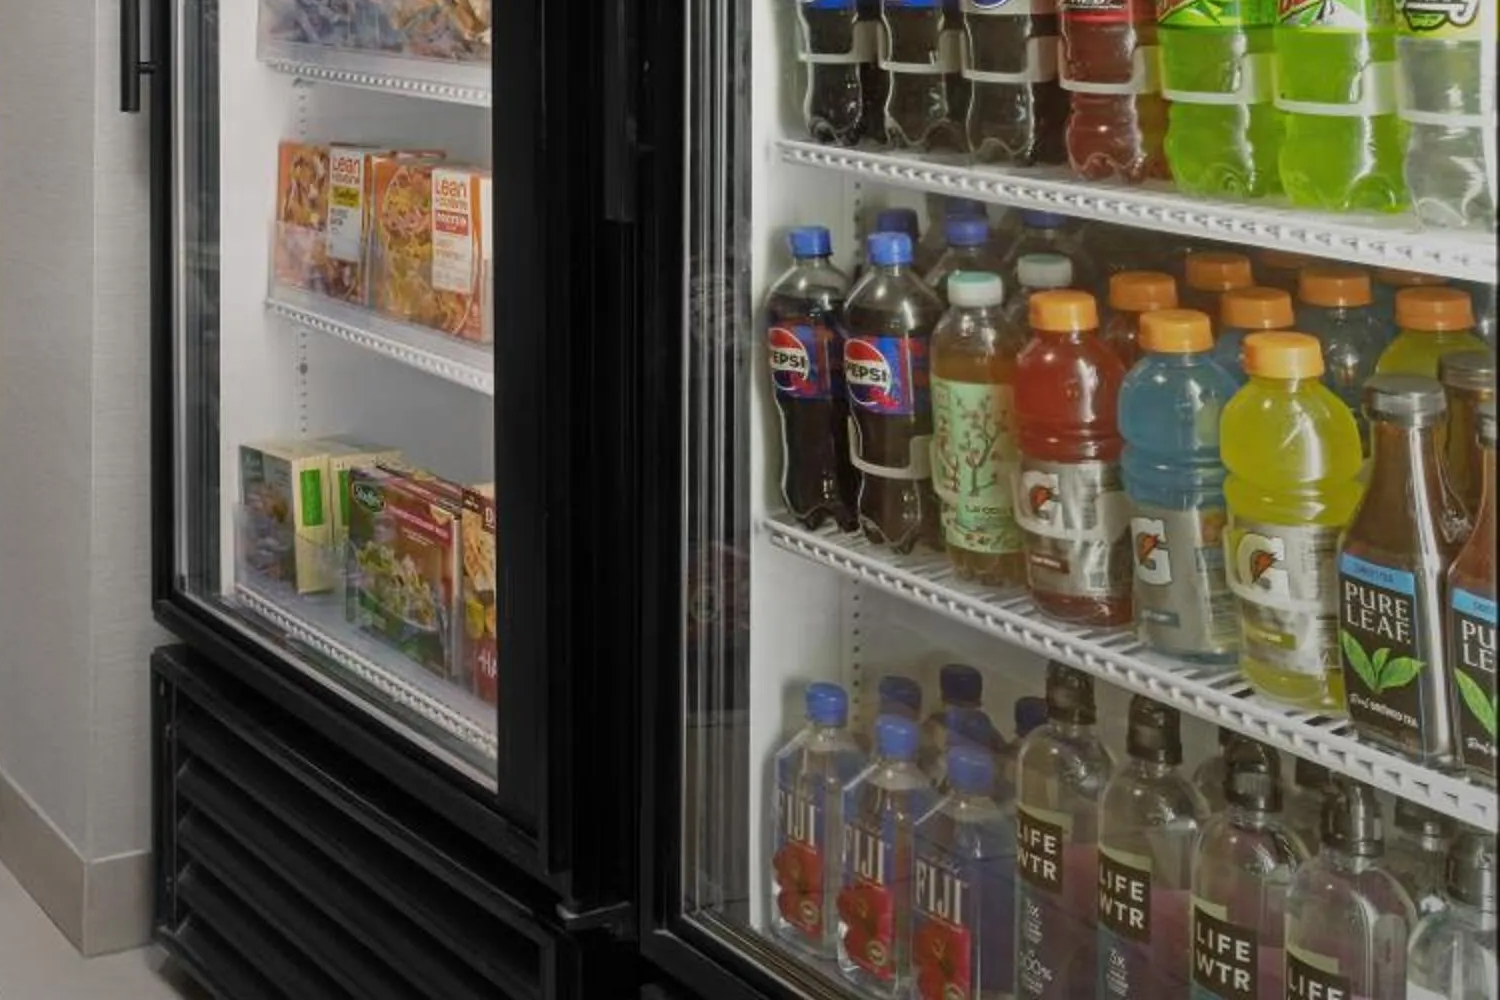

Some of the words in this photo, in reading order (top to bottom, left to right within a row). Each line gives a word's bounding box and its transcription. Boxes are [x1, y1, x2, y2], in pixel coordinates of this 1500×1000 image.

[333, 157, 361, 173] Lean
[435, 179, 468, 198] Lean
[1237, 533, 1291, 600] G
[1345, 581, 1411, 624] PURE
[1347, 603, 1408, 644] LEAF
[1015, 818, 1056, 855] LIFE
[915, 859, 962, 924] FIJI
[1098, 863, 1145, 903] LIFE
[1100, 891, 1144, 930] WTR
[1196, 921, 1250, 964] LIFE
[1196, 955, 1250, 993] WTR
